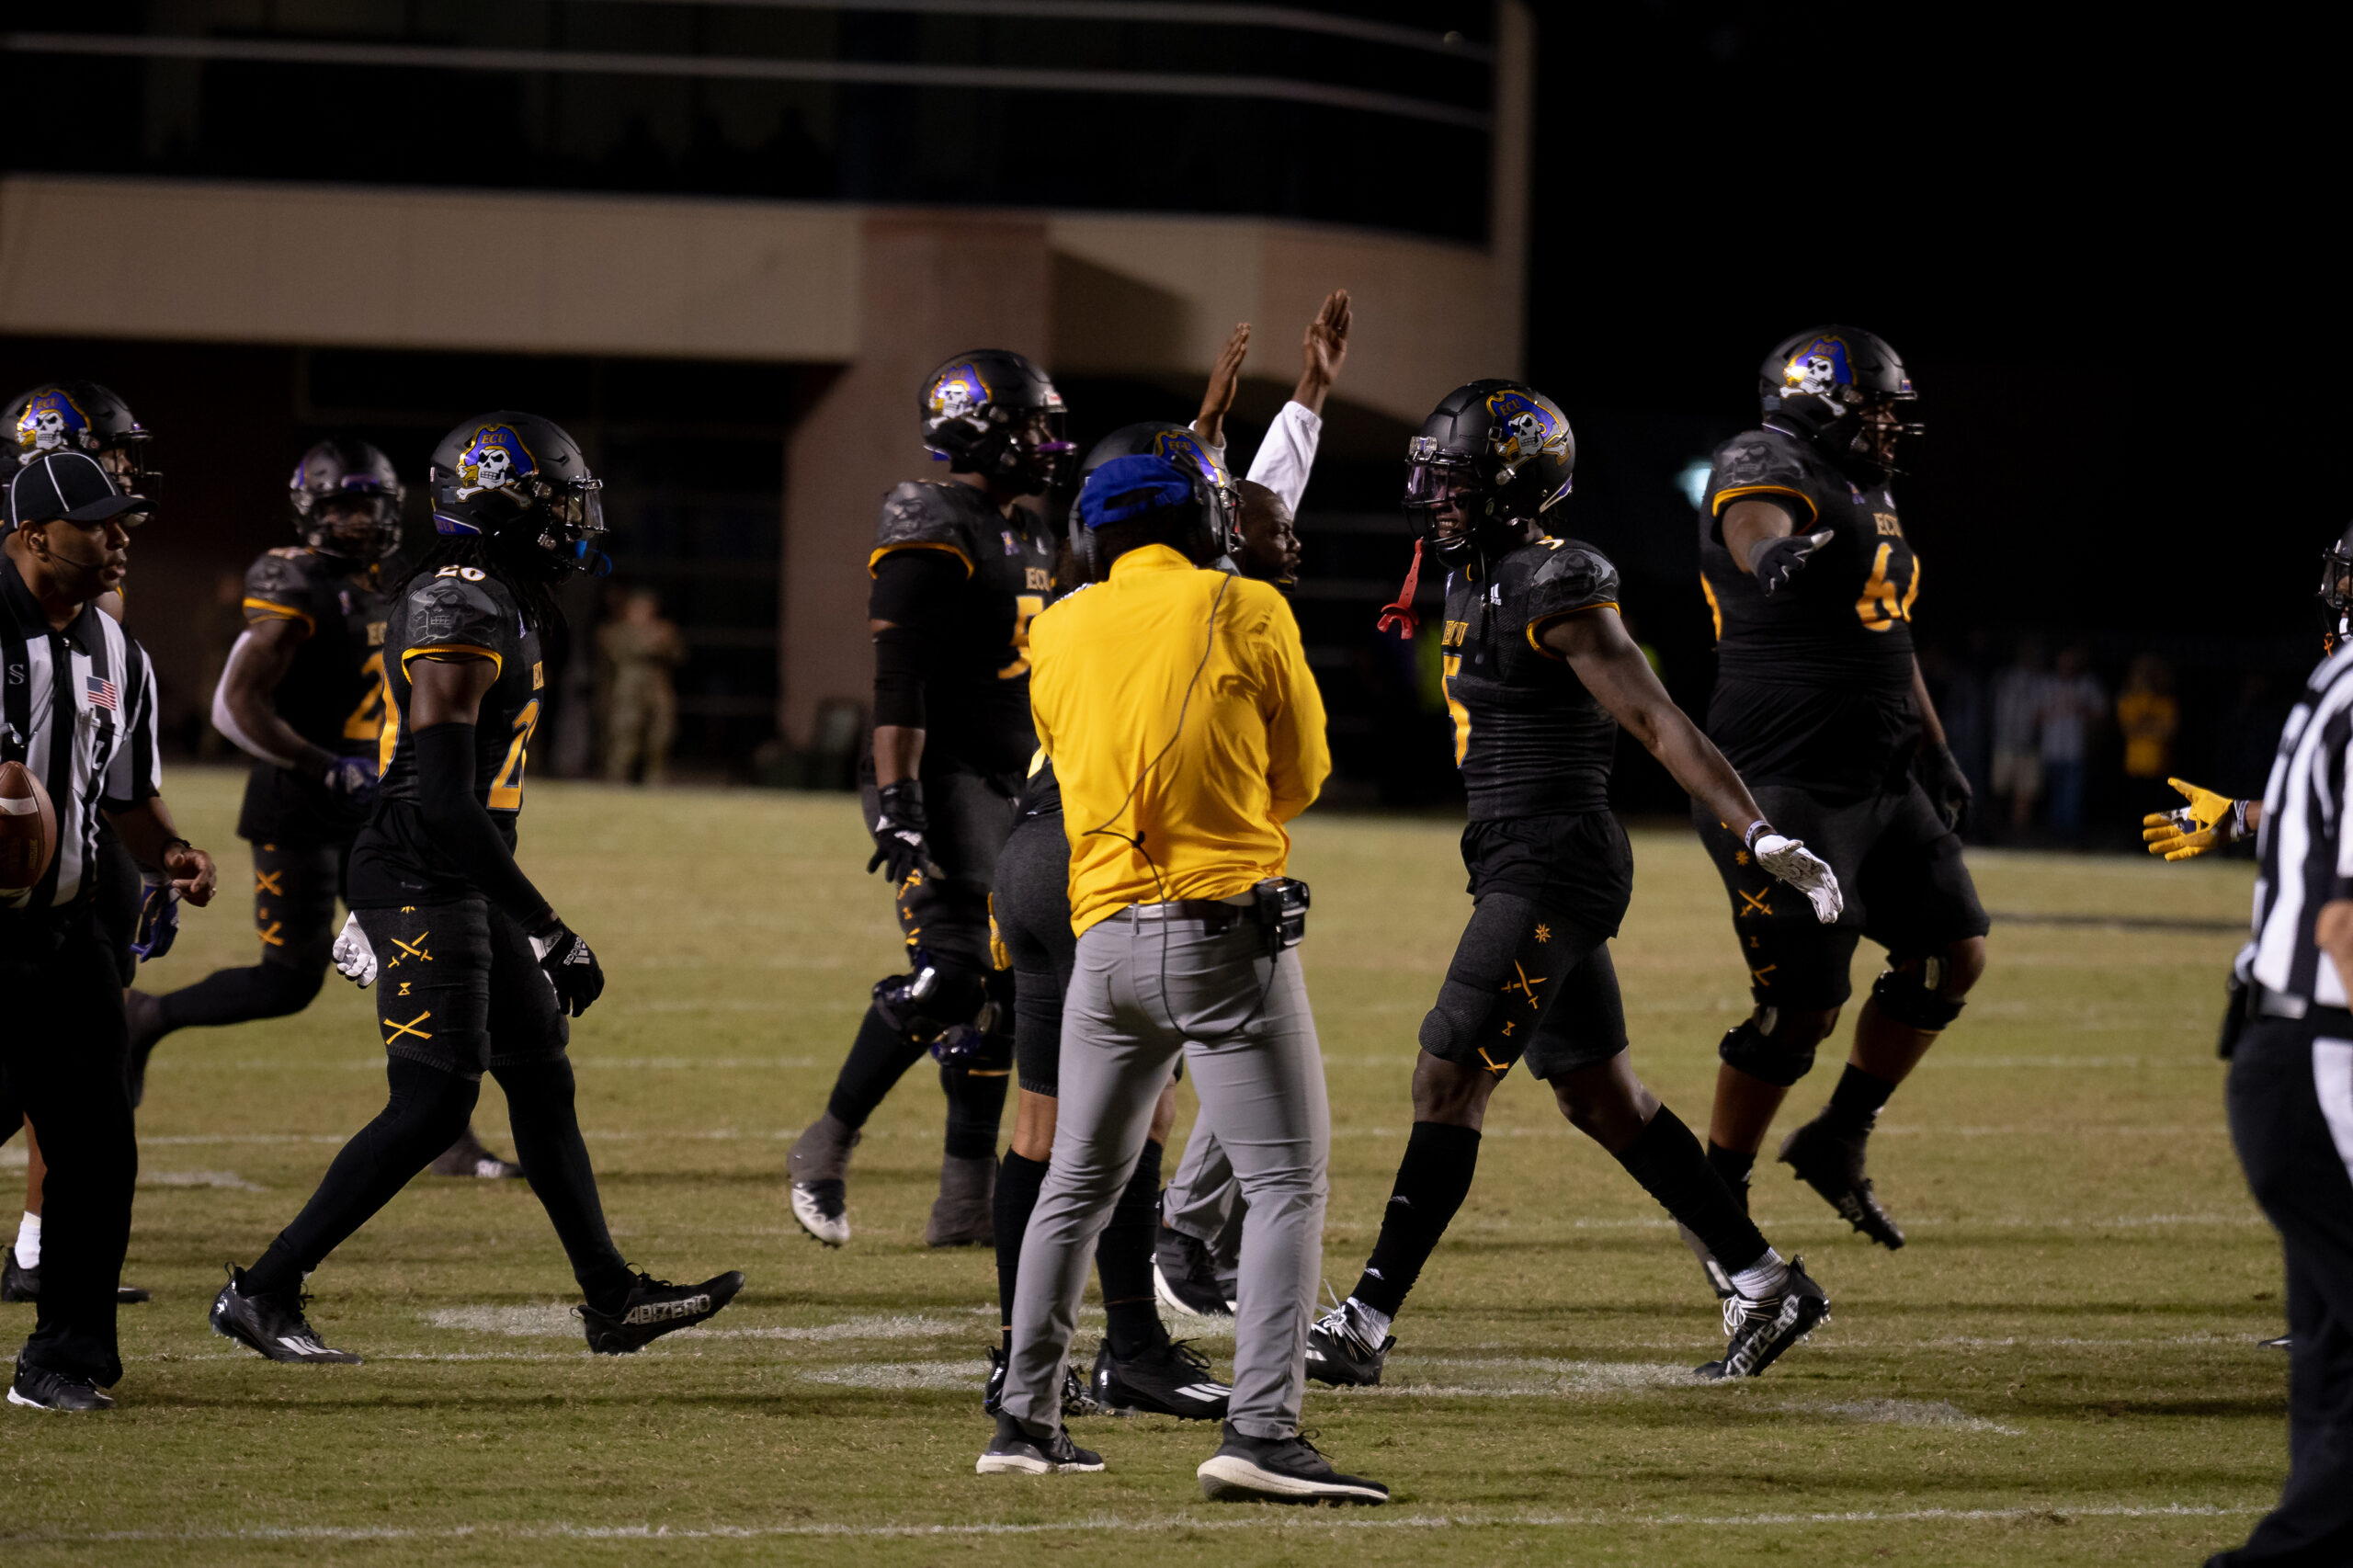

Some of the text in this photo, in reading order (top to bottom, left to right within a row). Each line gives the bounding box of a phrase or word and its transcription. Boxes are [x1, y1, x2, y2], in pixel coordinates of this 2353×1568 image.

[1499, 398, 1522, 416] ECU
[481, 433, 507, 444] ECU
[1168, 440, 1192, 450] ECU
[1441, 619, 1469, 647] ECU
[8, 663, 26, 686] S
[621, 1294, 711, 1325] ADIZERO
